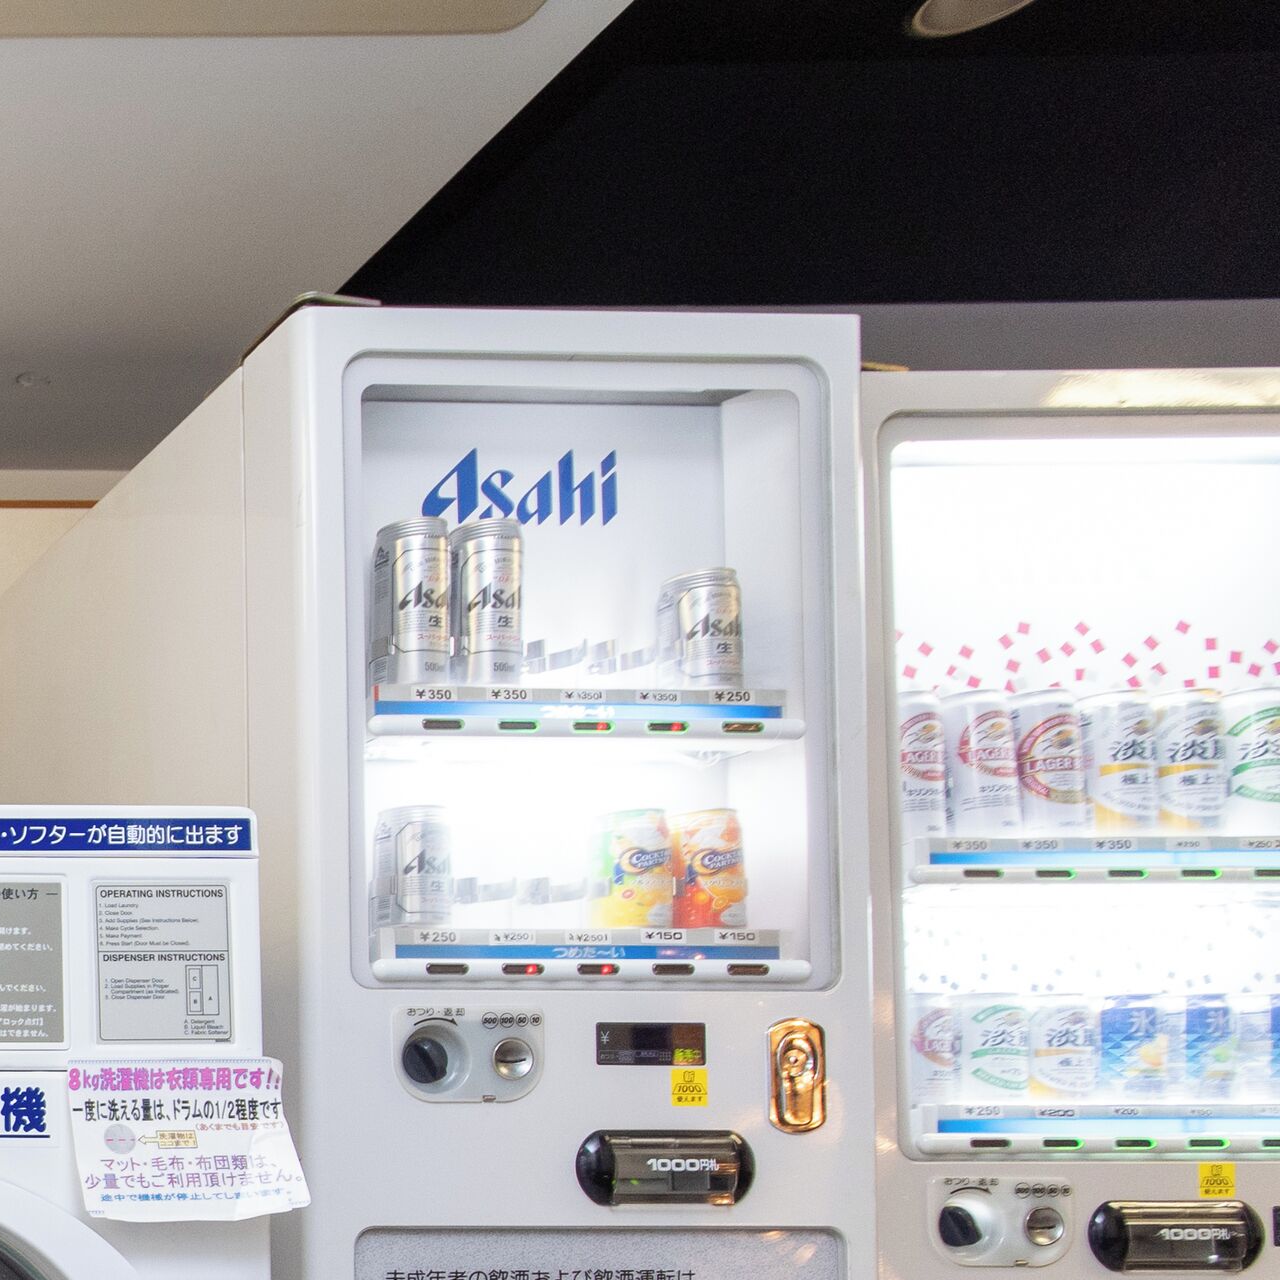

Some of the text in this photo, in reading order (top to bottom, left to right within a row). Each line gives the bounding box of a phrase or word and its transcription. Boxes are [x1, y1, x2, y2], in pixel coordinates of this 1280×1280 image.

[421, 447, 618, 527] Asahi
[416, 689, 527, 699] ¥350 ¥350
[714, 691, 750, 702] ¥250
[100, 890, 223, 898] OPERATING INSTRUCTIONS
[420, 932, 456, 942] ¥250
[645, 932, 755, 941] ¥150 ¥150
[103, 954, 225, 962] DISPENSER INSTRUCTIONS
